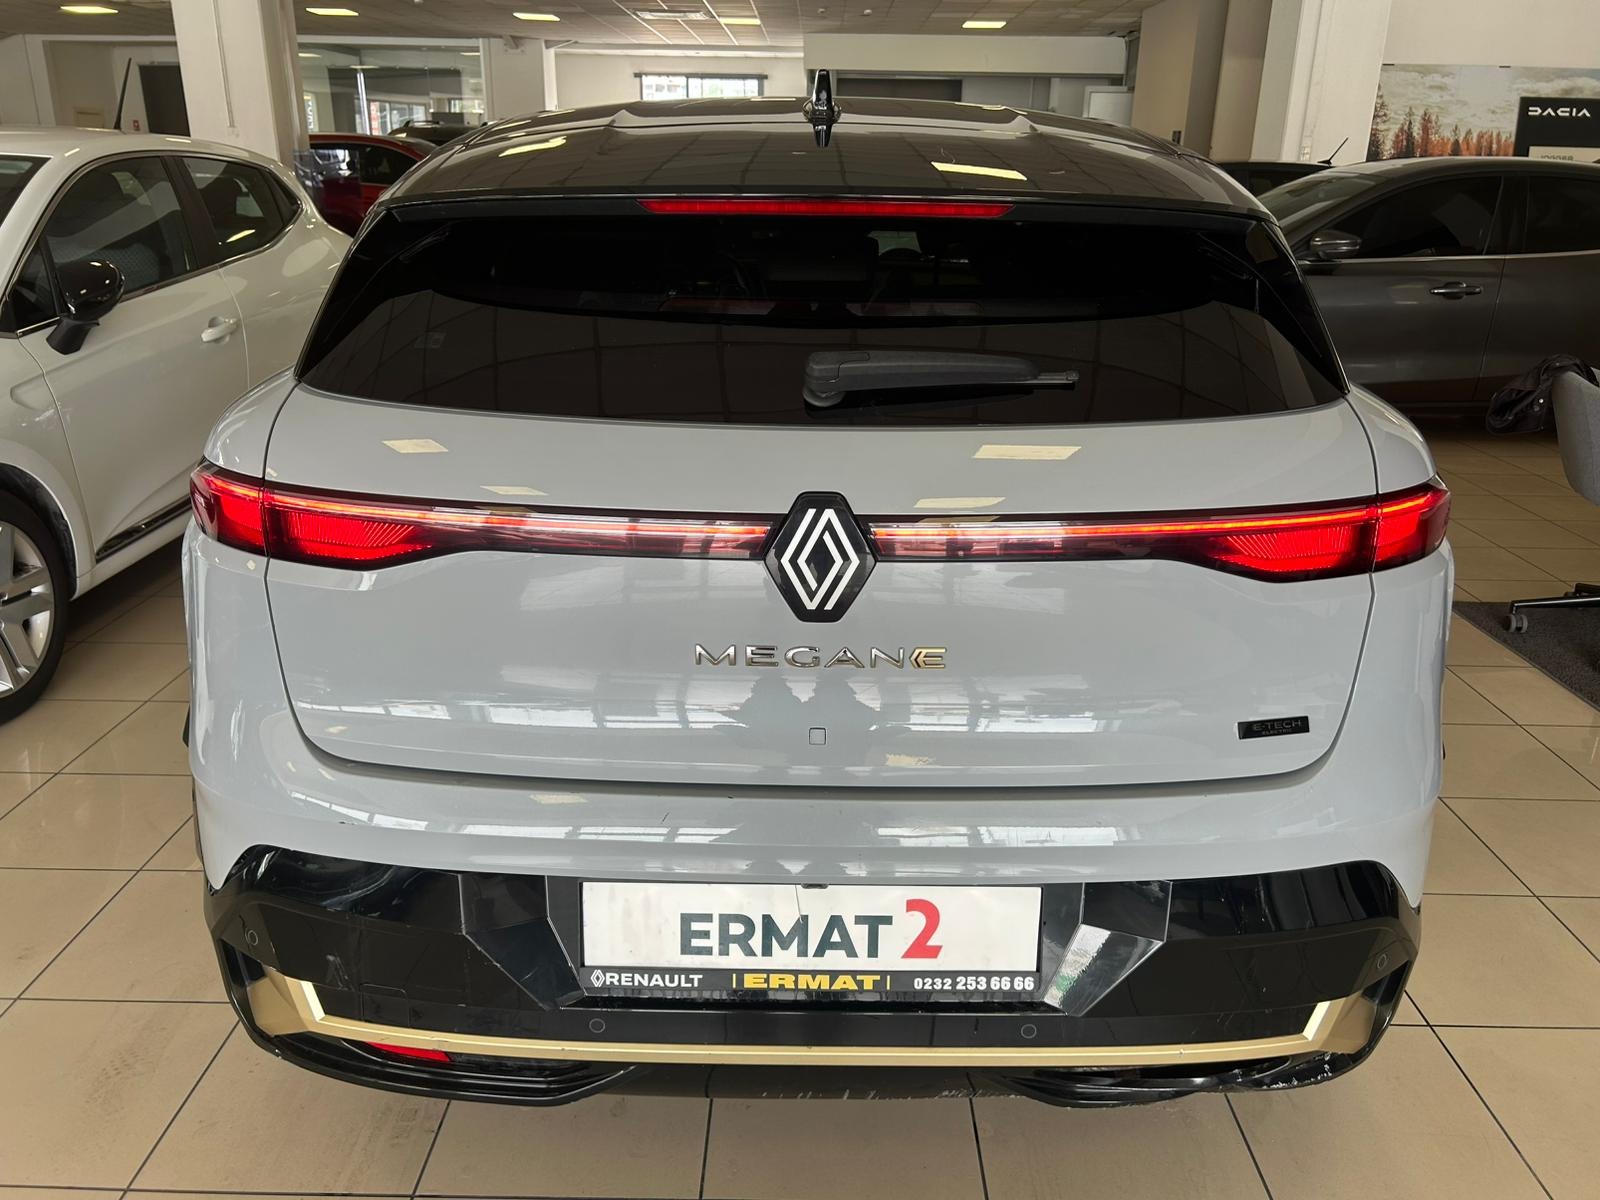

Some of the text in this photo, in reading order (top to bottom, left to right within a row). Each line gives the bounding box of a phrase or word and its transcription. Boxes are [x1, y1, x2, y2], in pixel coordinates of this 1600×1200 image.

[1527, 106, 1591, 117] DACIA
[695, 643, 948, 669] MEGANE
[679, 898, 943, 959] ERMAT 2
[605, 972, 1035, 991] RENAULT ERMAT 0232 253 66 66
